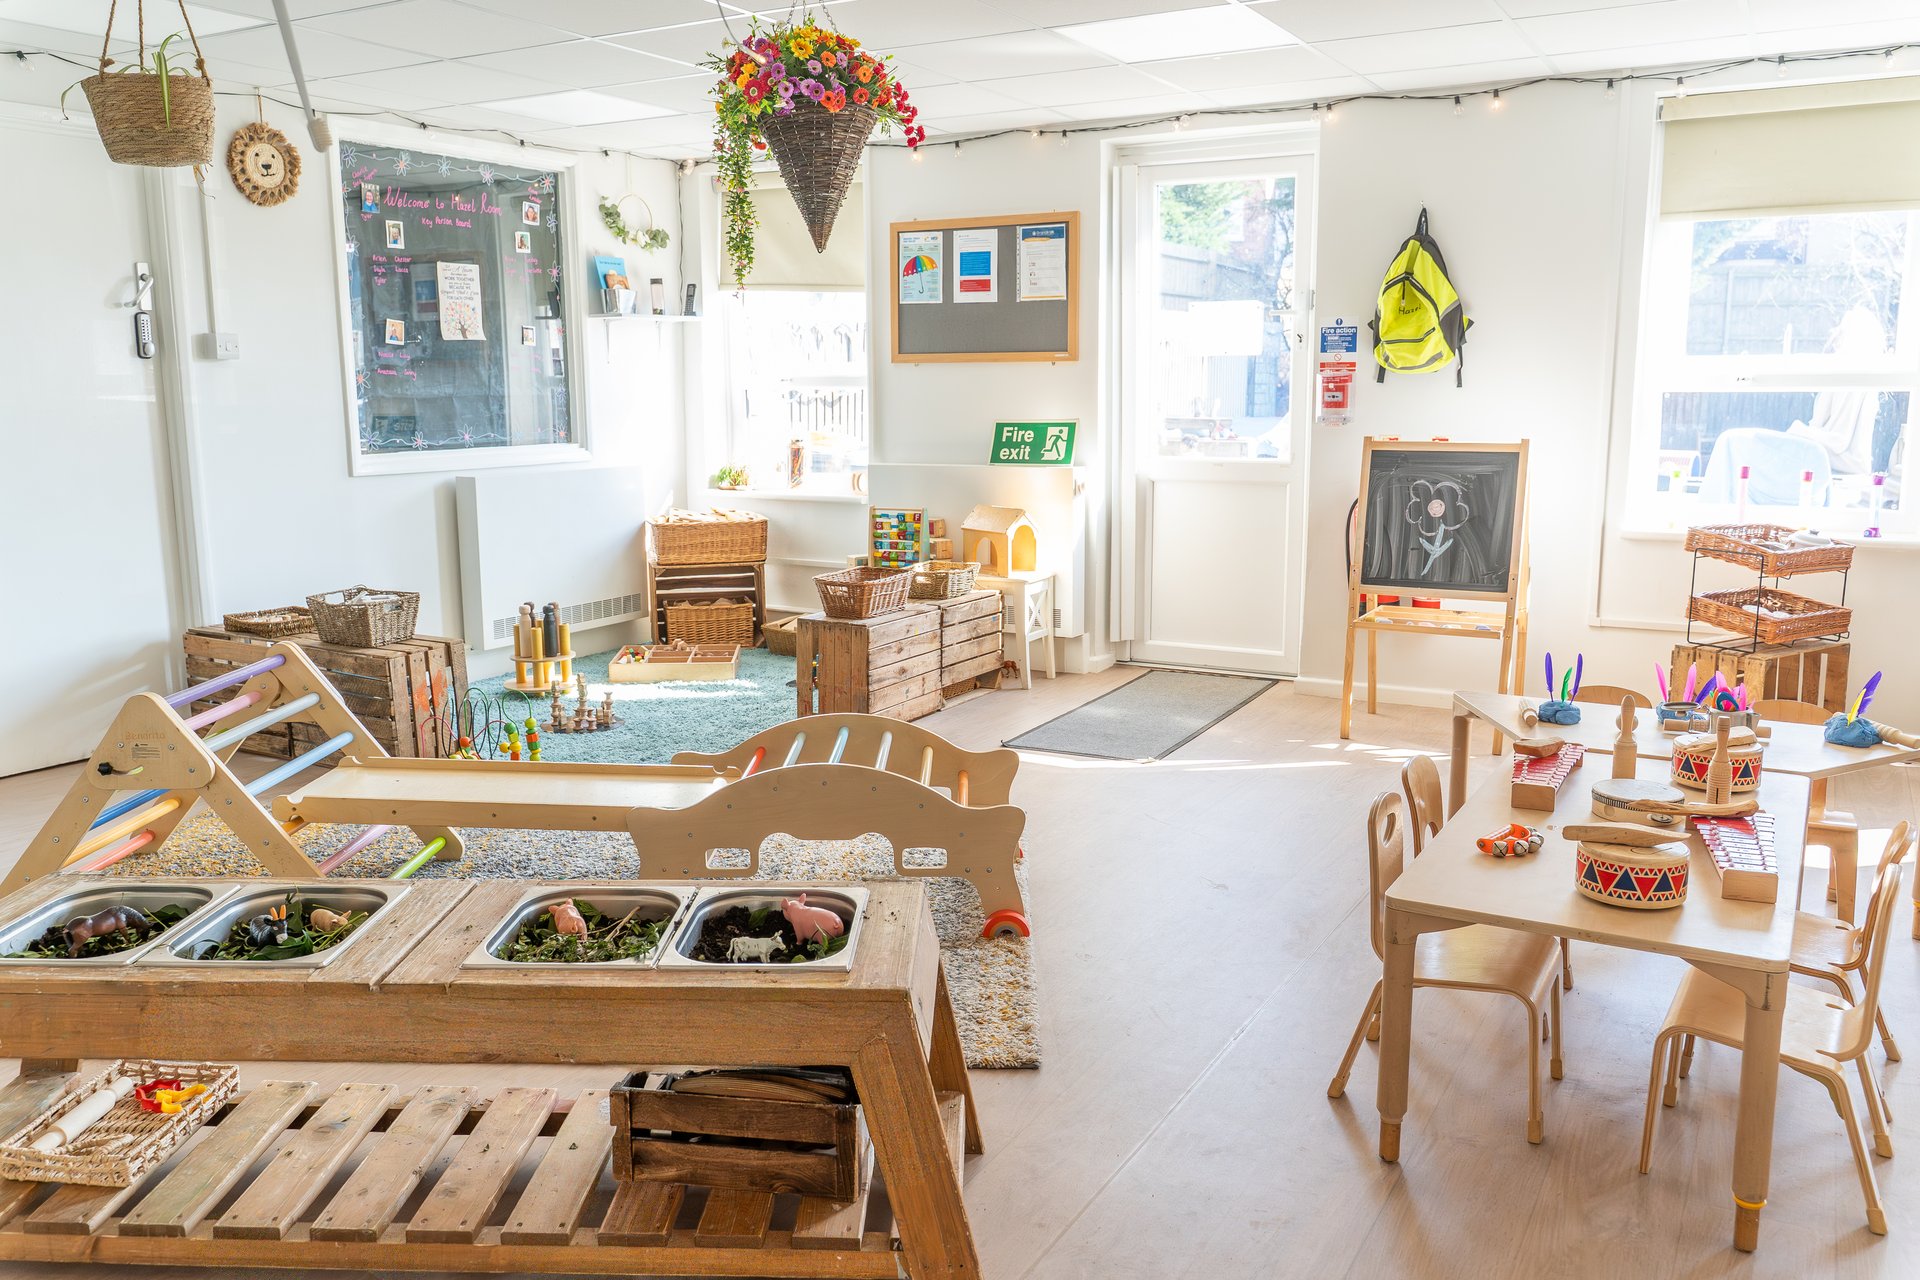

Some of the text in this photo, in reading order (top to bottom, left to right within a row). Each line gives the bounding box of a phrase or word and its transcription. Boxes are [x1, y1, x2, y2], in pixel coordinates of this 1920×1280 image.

[383, 185, 502, 216] Welcome to Hazel Room
[421, 216, 472, 228] Key Person Board
[1398, 303, 1421, 316] Hazel
[1002, 426, 1035, 443] Fire
[999, 444, 1031, 460] exit
